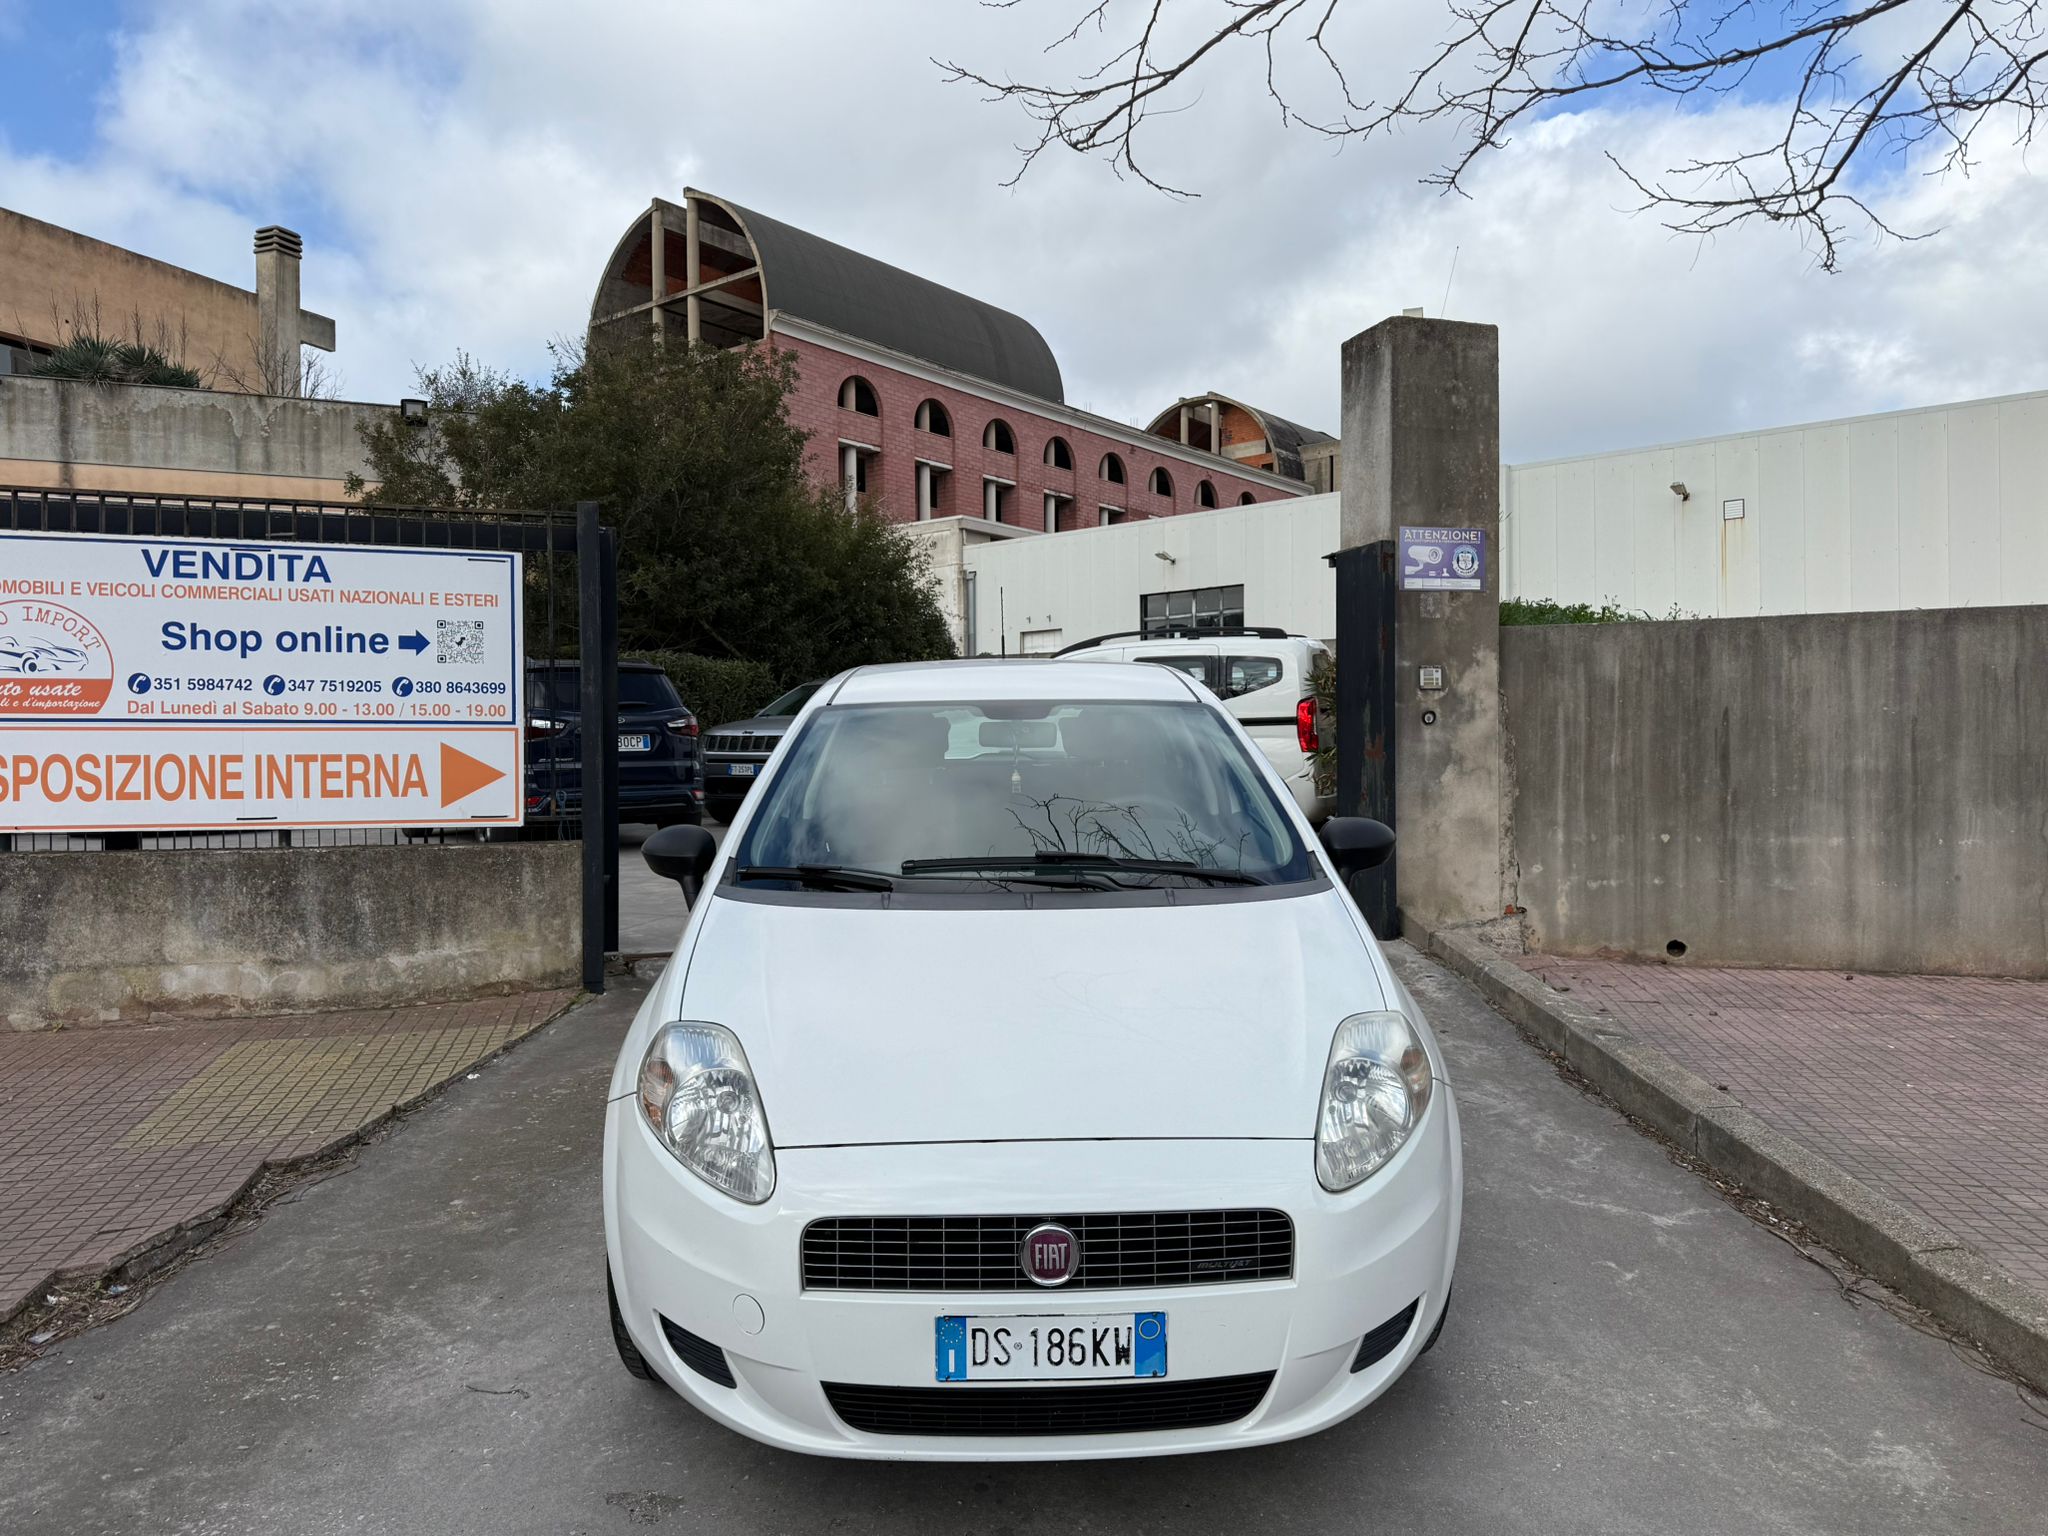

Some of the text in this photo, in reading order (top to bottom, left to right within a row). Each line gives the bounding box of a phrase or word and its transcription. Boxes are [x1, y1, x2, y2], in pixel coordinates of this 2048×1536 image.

[1404, 529, 1481, 541] ATTENZIONE!
[141, 549, 332, 583] VENDITA
[0, 580, 499, 608] MOBILI E VEICOLI COMMERCIALI USATI NAZIONALI E ESTERI
[22, 605, 102, 651] IMPORT
[161, 621, 390, 659] Shop online
[29, 682, 82, 697] usate
[153, 678, 506, 695] 351 5984742 347 7519205 380 8643699
[22, 696, 101, 711] d'importazione
[127, 700, 154, 714] Dal
[160, 700, 217, 715] Lunedì
[222, 701, 237, 715] al
[242, 701, 299, 716] Sabato
[304, 703, 337, 716] 9.00
[353, 703, 395, 717] 13.00
[410, 703, 451, 717] 15.00
[467, 704, 506, 718] 19.00
[255, 753, 429, 801] INTERNA
[1034, 1242, 1068, 1271] FIAT
